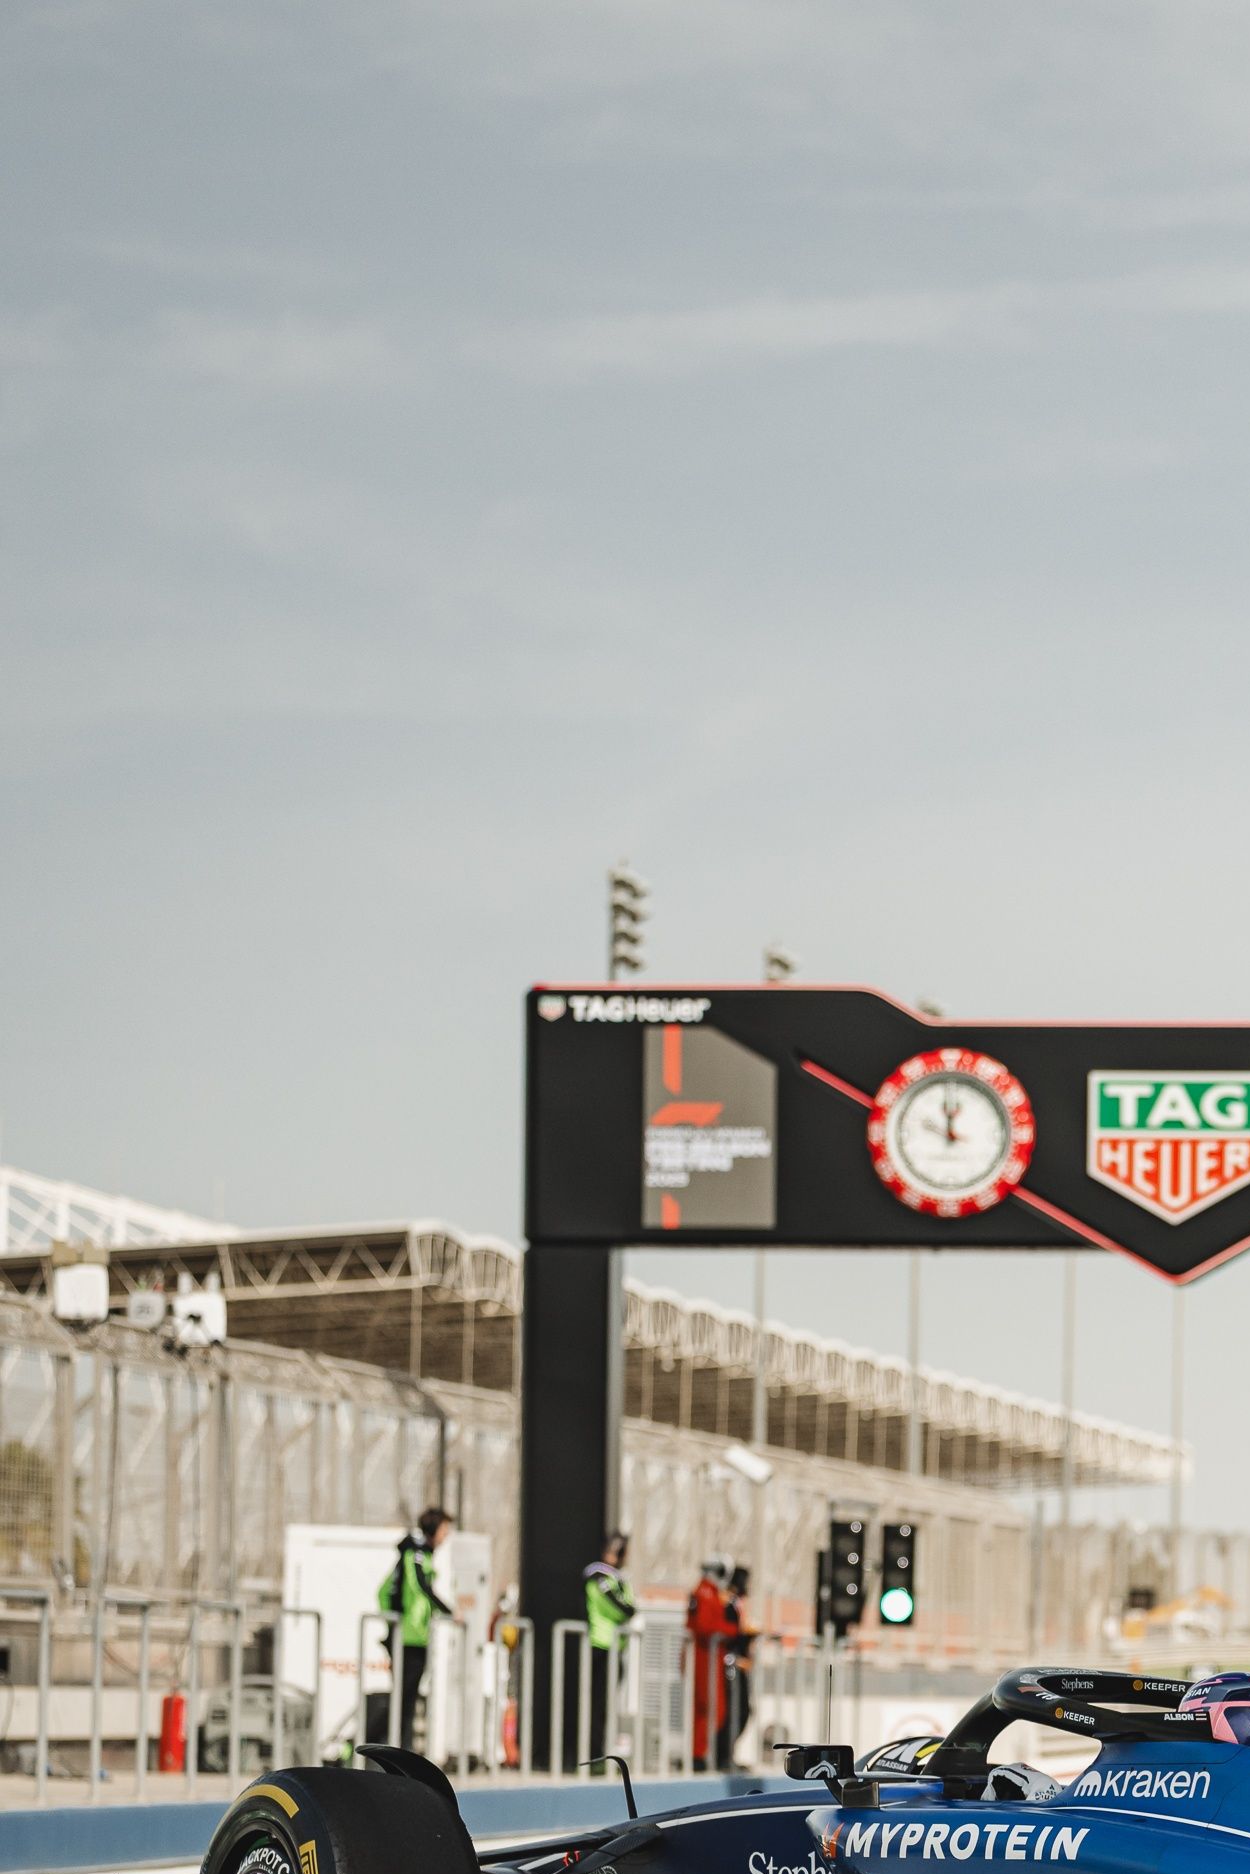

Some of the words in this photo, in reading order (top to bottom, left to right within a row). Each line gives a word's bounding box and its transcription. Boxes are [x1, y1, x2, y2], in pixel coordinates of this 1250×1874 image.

[1103, 1084, 1248, 1129] TAG
[1100, 1141, 1250, 1207] HEUER
[1061, 1678, 1094, 1691] Stephens
[1144, 1682, 1186, 1692] KEEPER
[1063, 1710, 1095, 1725] KEEPER
[1164, 1713, 1194, 1721] ALBON
[1102, 1768, 1211, 1799] kraken
[844, 1822, 1092, 1861] MYPROTEIN
